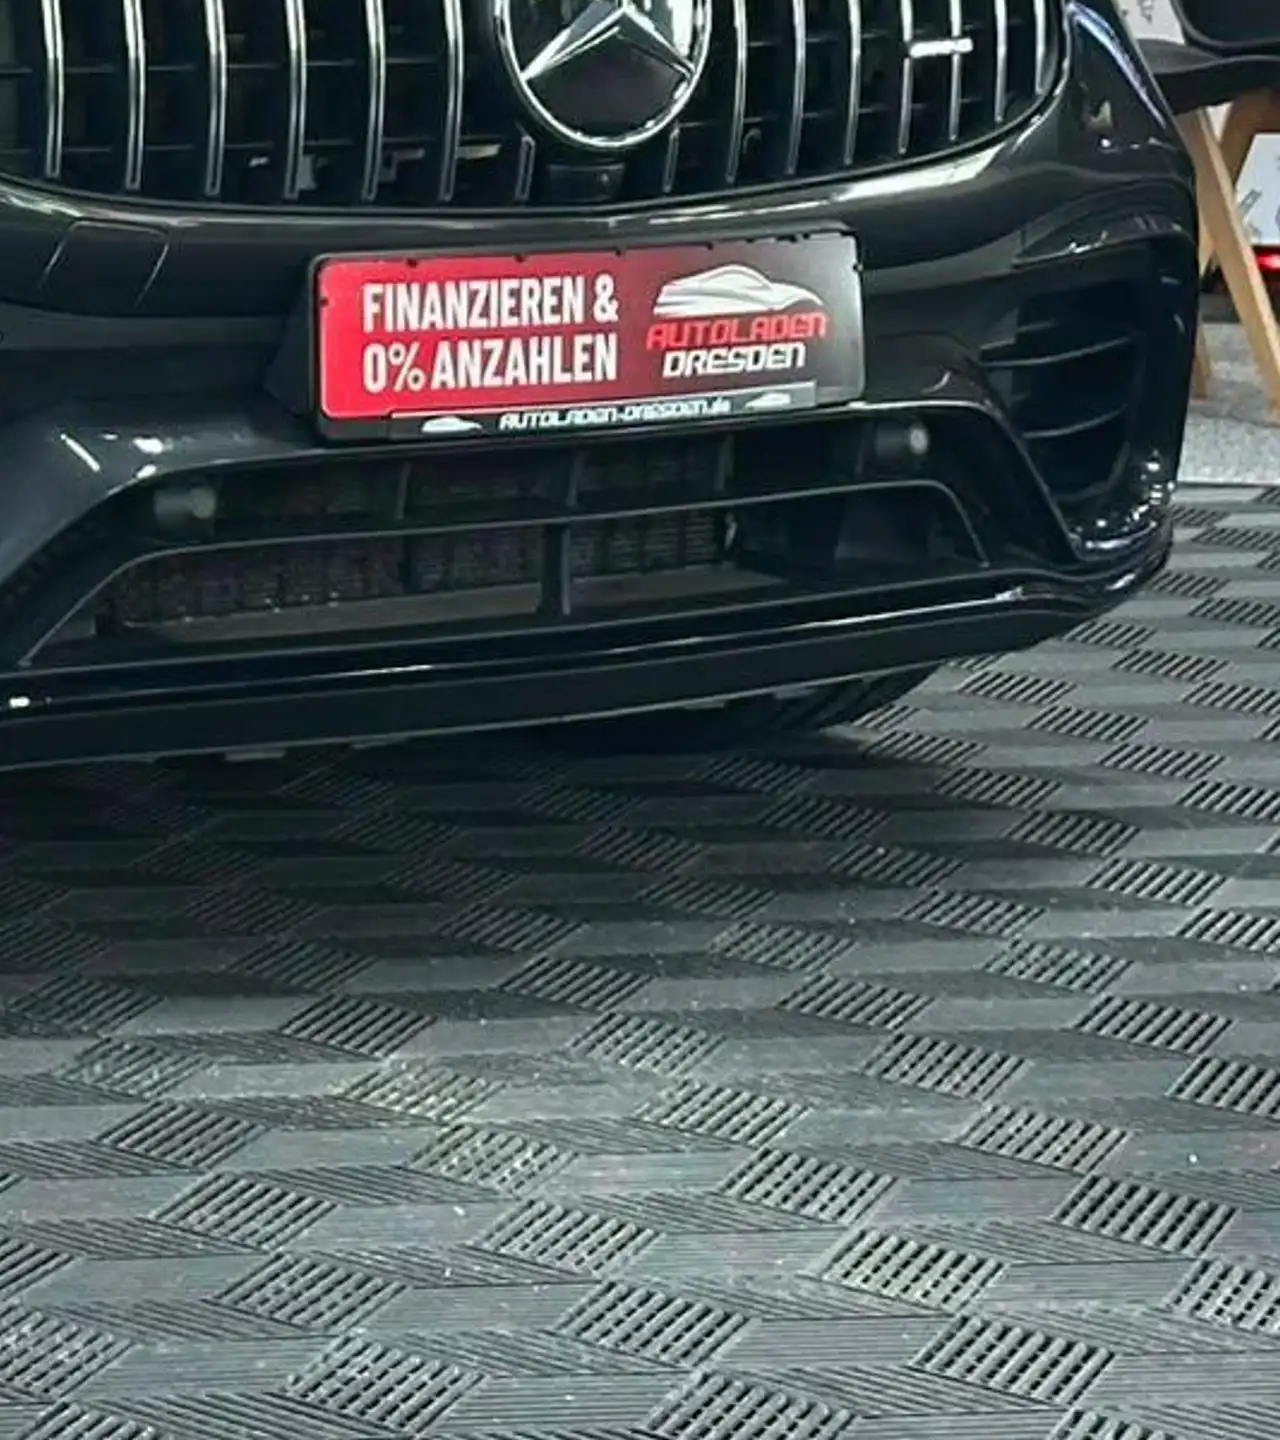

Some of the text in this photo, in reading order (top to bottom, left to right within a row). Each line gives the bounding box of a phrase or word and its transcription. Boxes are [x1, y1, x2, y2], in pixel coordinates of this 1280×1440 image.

[362, 273, 620, 333] FINANZIEREN &
[645, 311, 829, 351] AUTOLADEN
[362, 332, 619, 394] 0% ANZAHLEN
[661, 341, 807, 378] DRESDEN
